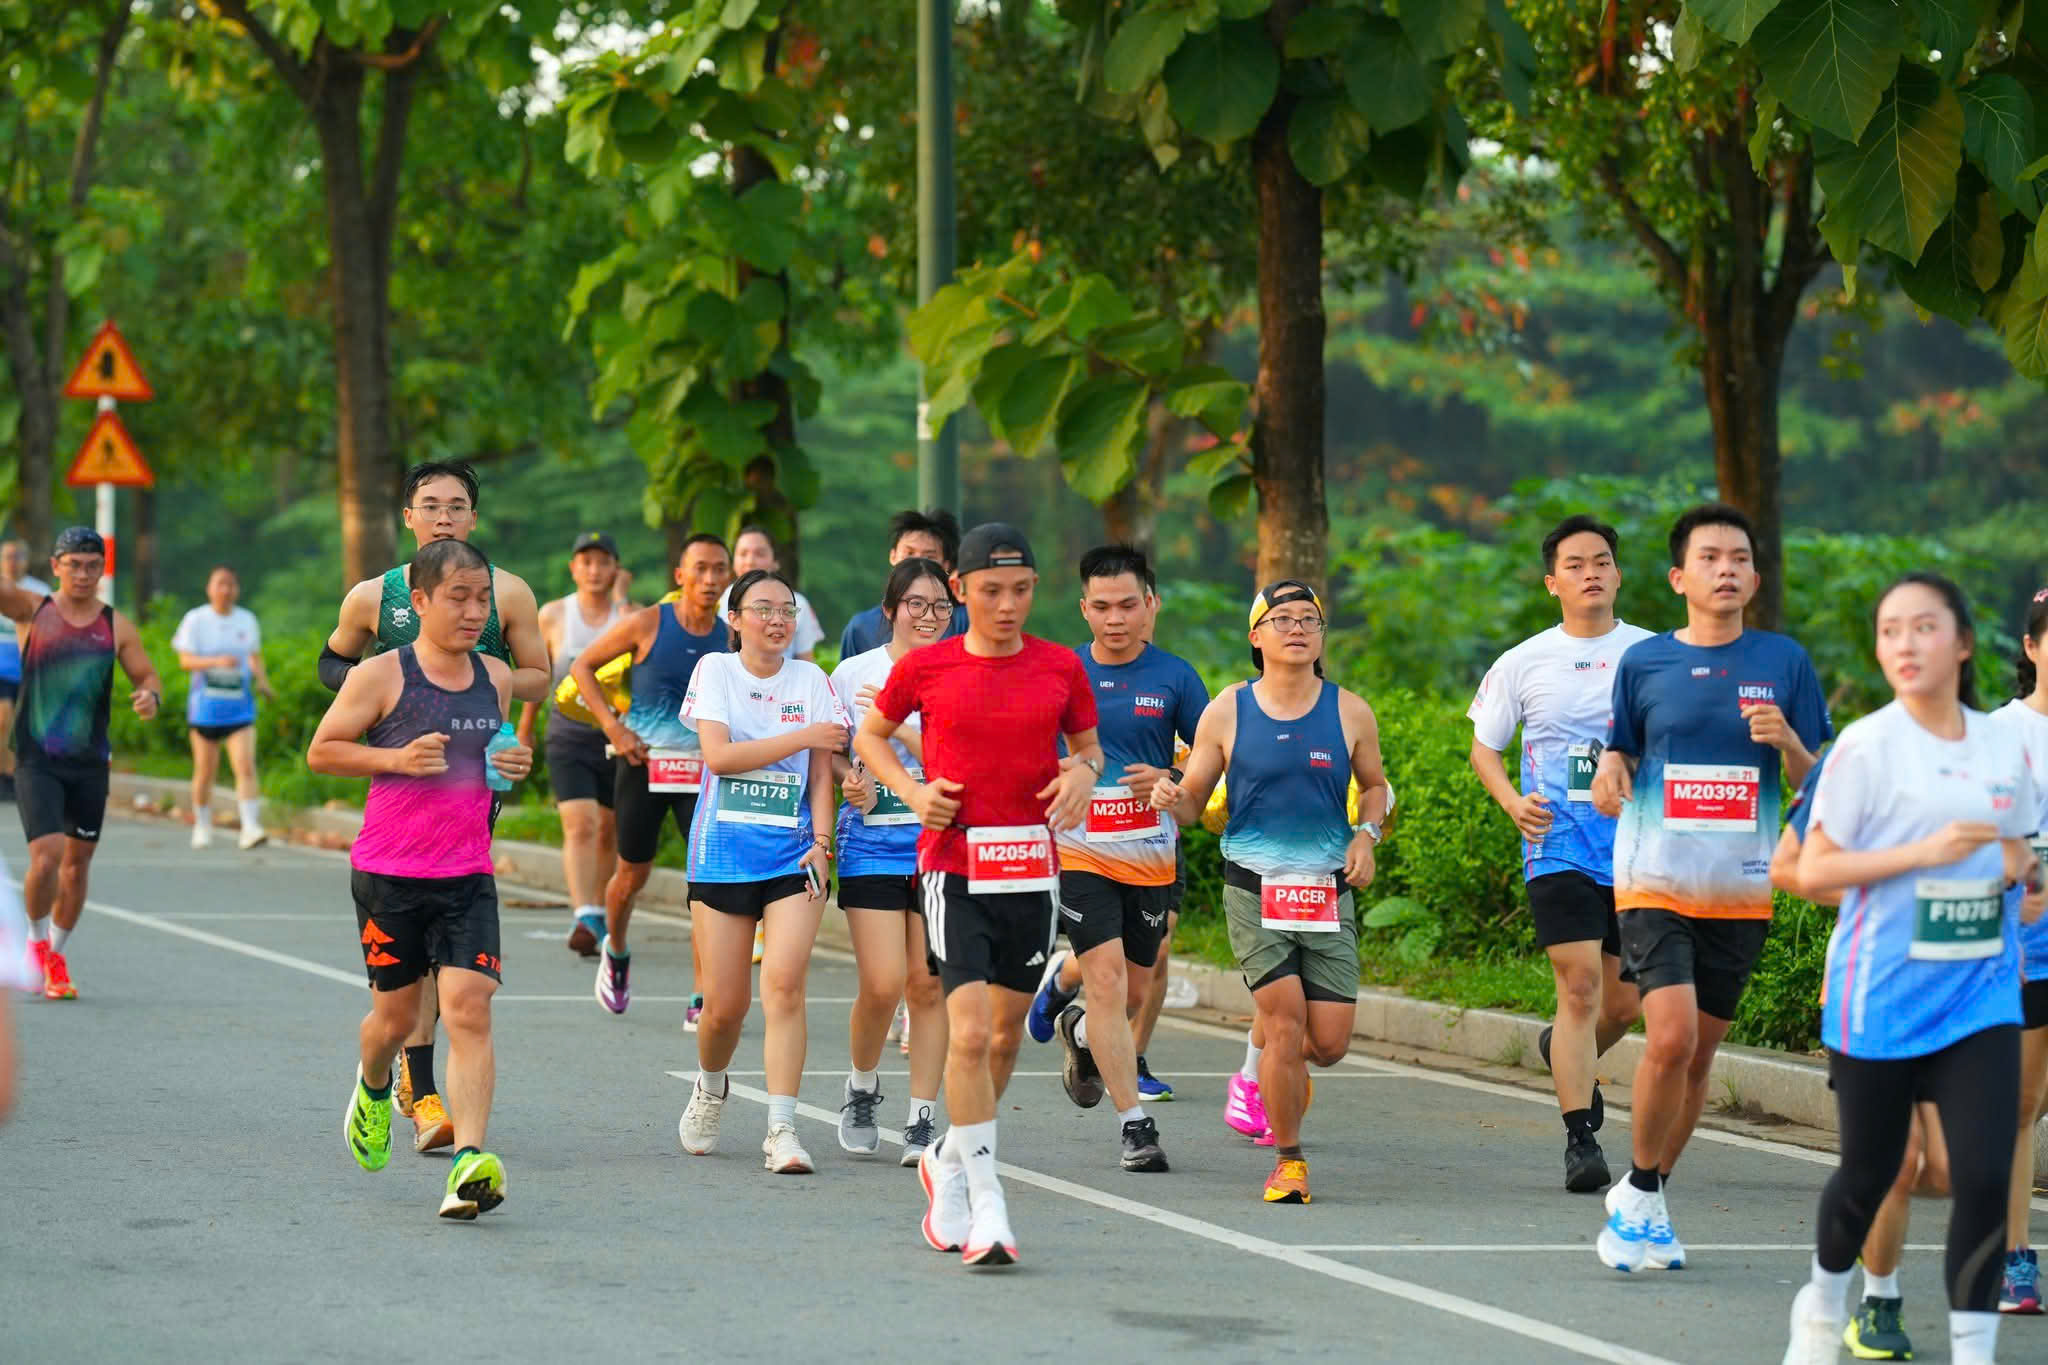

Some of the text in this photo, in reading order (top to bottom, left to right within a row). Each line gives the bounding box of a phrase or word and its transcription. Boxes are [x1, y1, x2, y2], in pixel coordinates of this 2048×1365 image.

[1575, 661, 1591, 669] UEH
[1099, 680, 1115, 688] UEH
[1738, 685, 1768, 699] UEH
[1135, 696, 1159, 708] UEH
[781, 704, 801, 714] UEH
[451, 718, 498, 730] RACE
[788, 775, 796, 784] 10
[730, 781, 789, 800] F10178
[1673, 783, 1749, 801] M20392
[978, 843, 1047, 862] M20540
[1275, 888, 1327, 905] PACER
